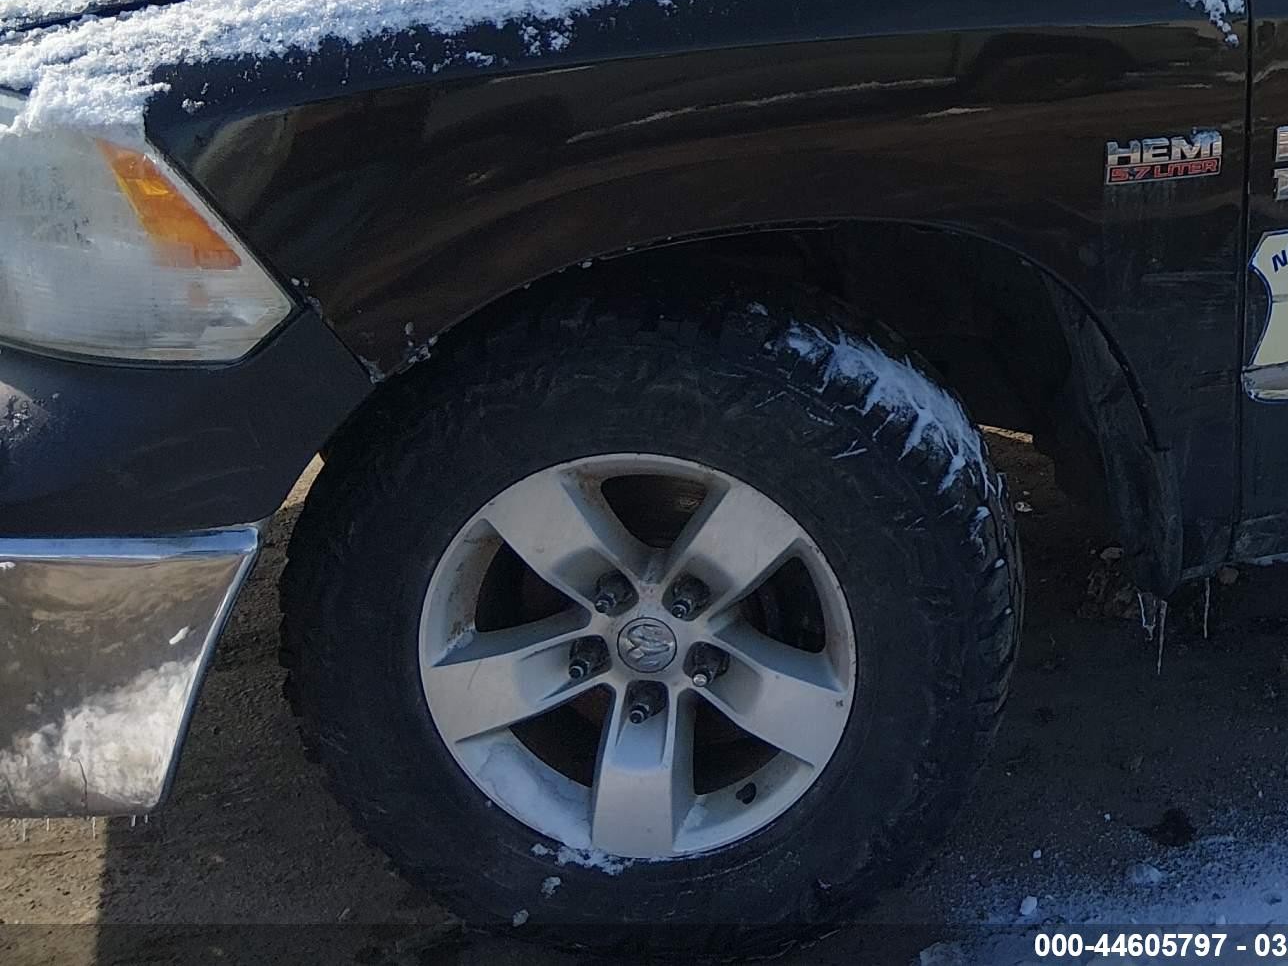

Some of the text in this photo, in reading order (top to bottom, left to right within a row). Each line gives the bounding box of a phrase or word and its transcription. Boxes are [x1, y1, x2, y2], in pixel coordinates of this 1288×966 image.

[1106, 131, 1222, 165] HEMI
[1111, 158, 1218, 182] 5.7 LITER
